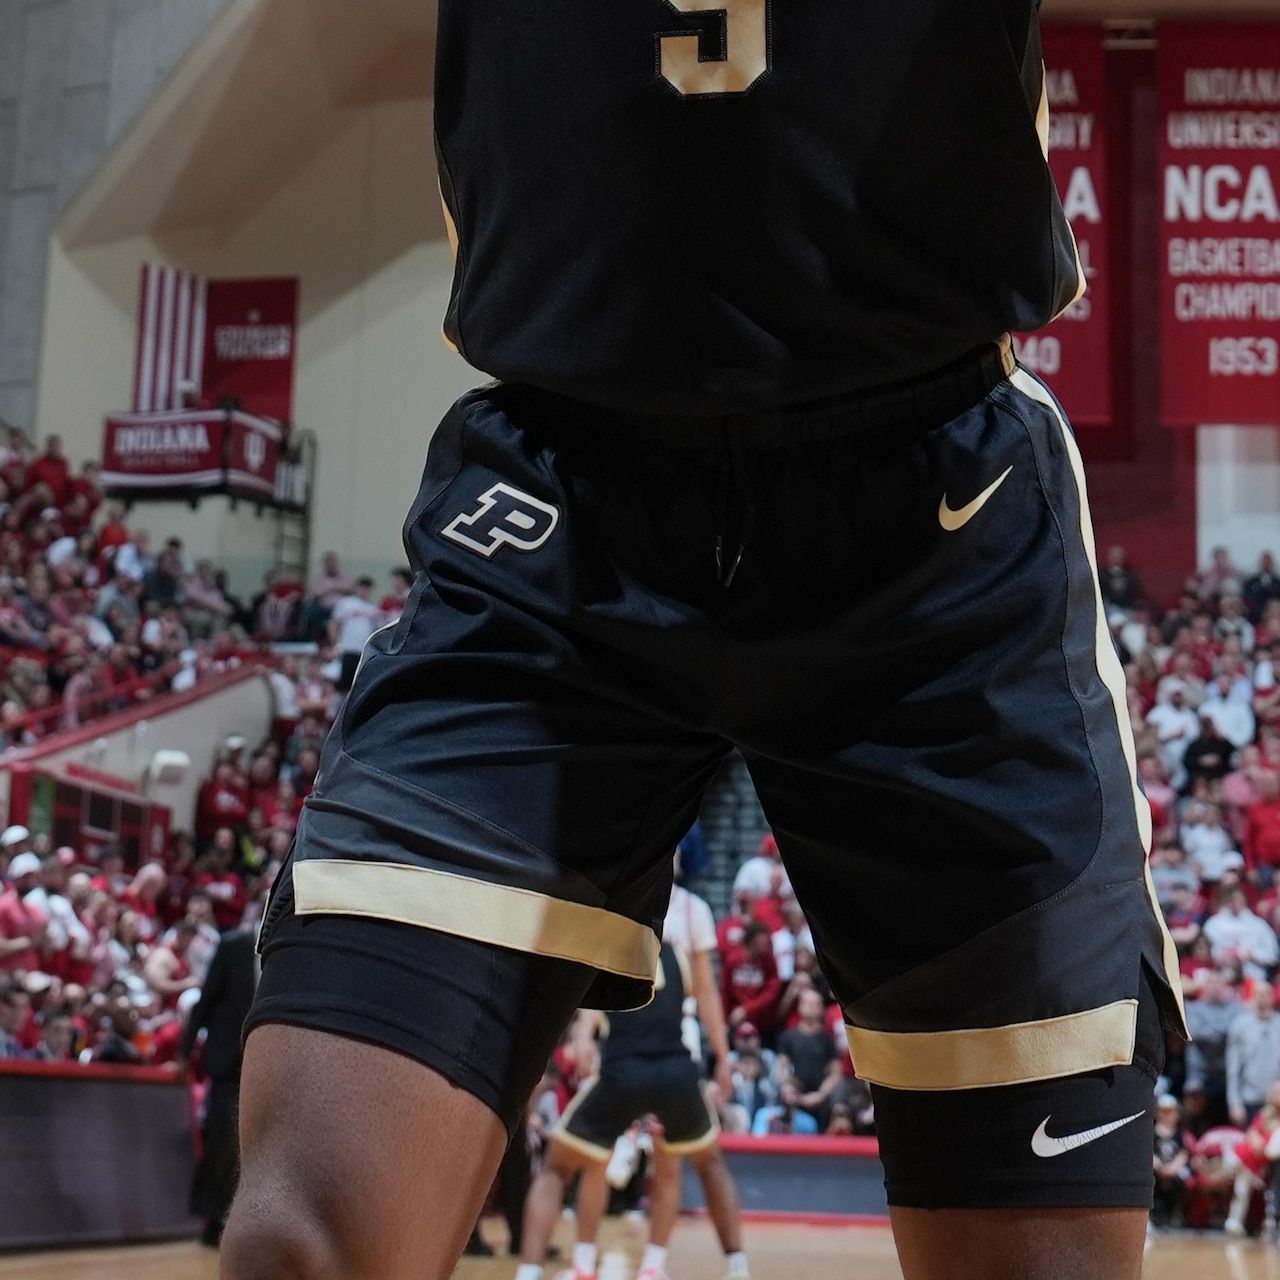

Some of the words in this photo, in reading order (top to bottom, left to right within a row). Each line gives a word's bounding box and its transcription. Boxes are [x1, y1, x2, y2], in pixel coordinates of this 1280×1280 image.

[1209, 337, 1278, 375] 1953
[114, 424, 210, 456] INDIANA
[441, 482, 558, 556] P
